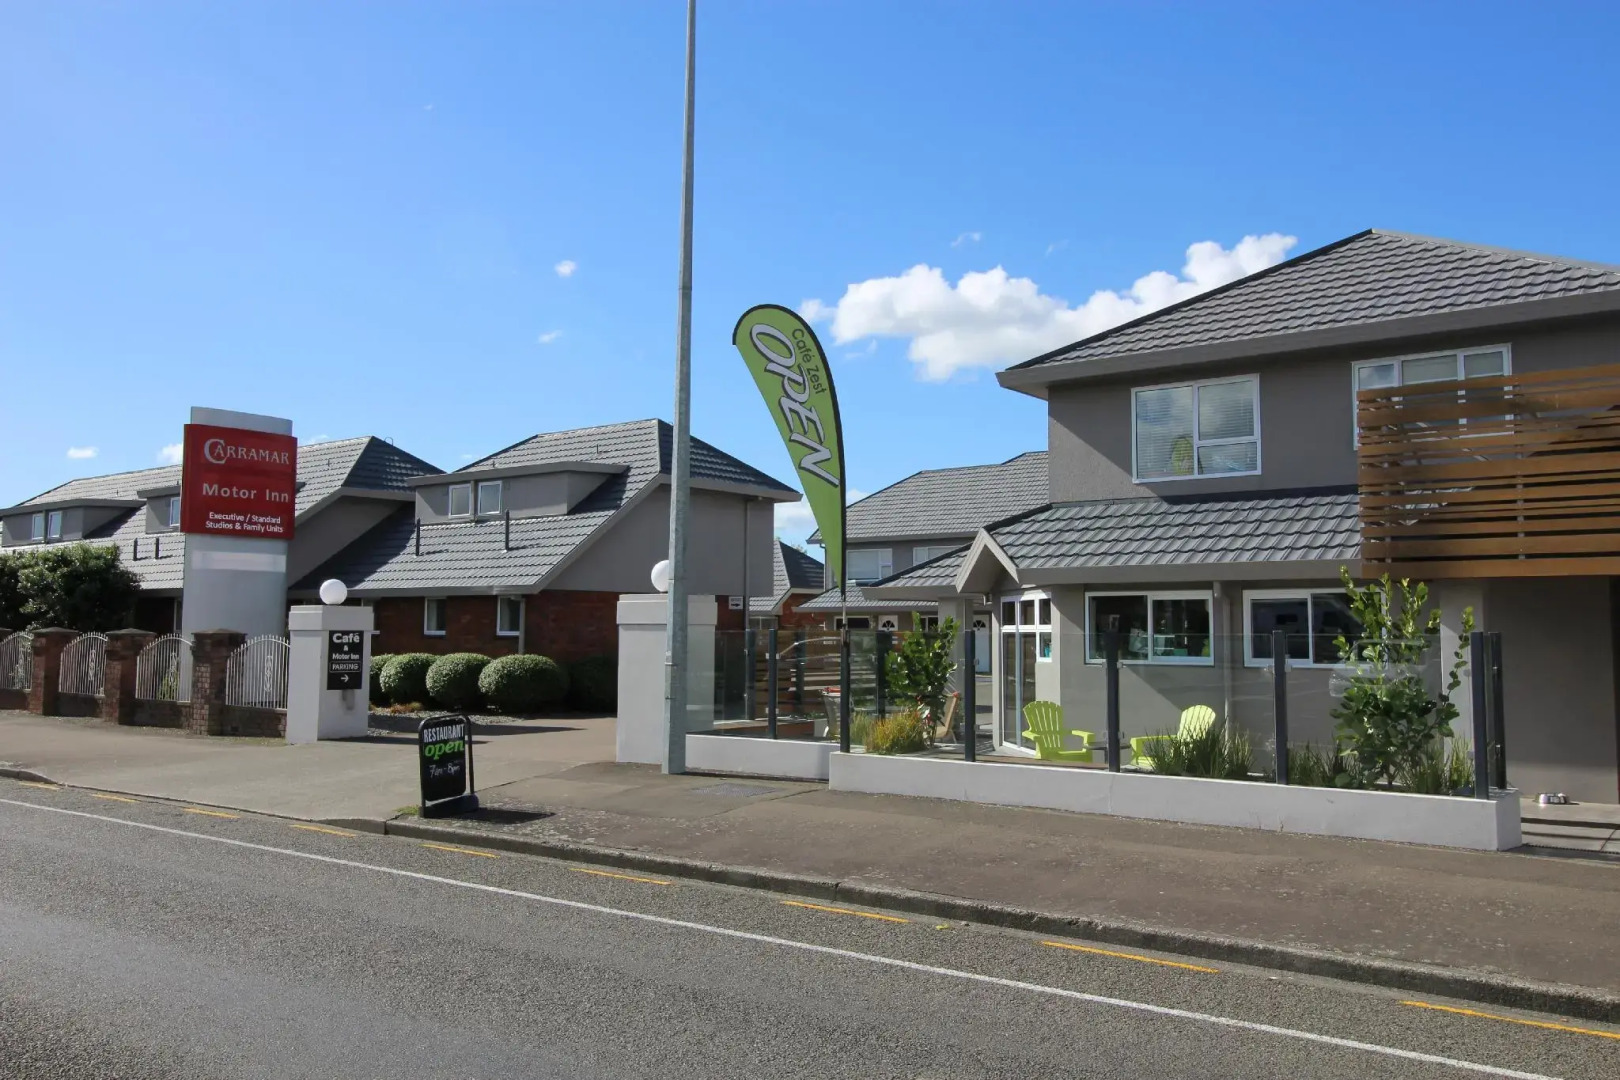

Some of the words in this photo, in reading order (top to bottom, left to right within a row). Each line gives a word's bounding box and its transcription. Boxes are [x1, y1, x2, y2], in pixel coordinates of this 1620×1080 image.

[792, 329, 814, 363] Café
[806, 365, 827, 394] Zest
[750, 323, 840, 487] OPEN
[202, 483, 257, 499] Motor
[265, 489, 289, 503] Inn
[205, 521, 233, 530] Studios
[234, 522, 242, 530] &
[243, 523, 265, 533] Family
[266, 525, 283, 533] Units
[209, 512, 244, 521] Executive
[252, 515, 281, 524] Standard
[332, 633, 359, 643] Café
[424, 724, 464, 742] RESTAURANT
[425, 740, 464, 760] open
